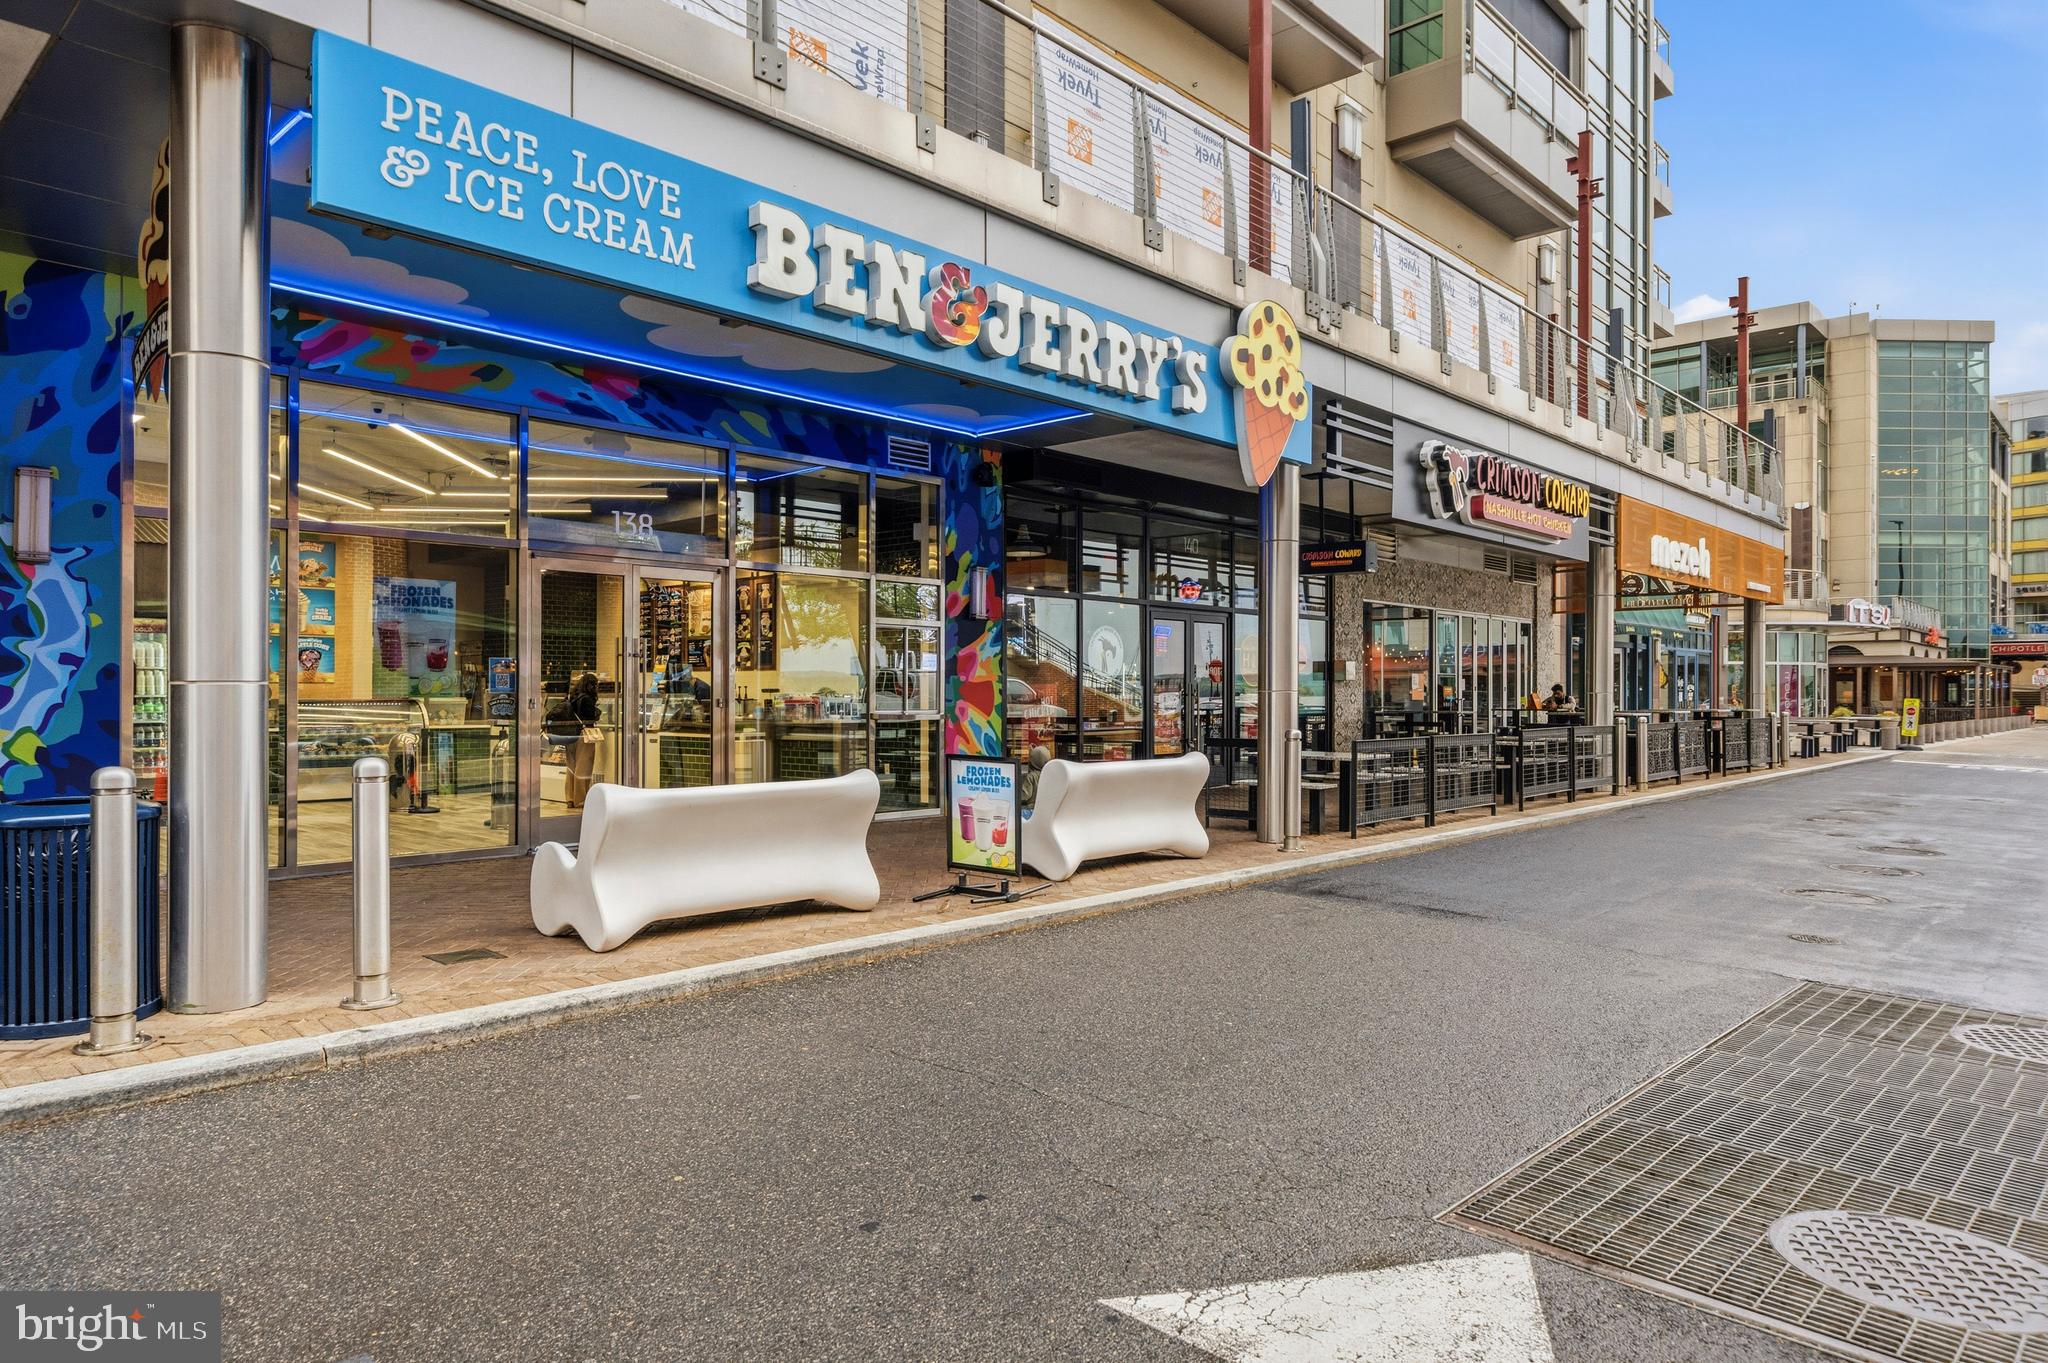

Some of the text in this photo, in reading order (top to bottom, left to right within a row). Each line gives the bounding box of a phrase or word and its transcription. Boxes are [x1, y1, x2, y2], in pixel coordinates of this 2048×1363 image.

[850, 41, 870, 91] vek
[1055, 49, 1099, 82] HomeWrap
[1057, 68, 1102, 109] Tyvek
[381, 86, 681, 219] PEACE, LOVE
[1195, 144, 1223, 171] yvek
[380, 146, 696, 270] & ICE CREAM
[1477, 455, 1590, 518] CRIMSON COWARD
[611, 510, 653, 537] 138
[1485, 501, 1527, 523] NASHVILLE
[1528, 512, 1541, 526] HOT
[1184, 537, 1199, 554] 140
[1302, 549, 1361, 560] CRIMSON COWARD
[1651, 535, 1710, 579] mezeh
[391, 584, 440, 597] FROZEN
[1991, 645, 2044, 653] CHIPOTLE
[957, 775, 1011, 788] LEMONADES
[966, 766, 1001, 776] FROZEN
